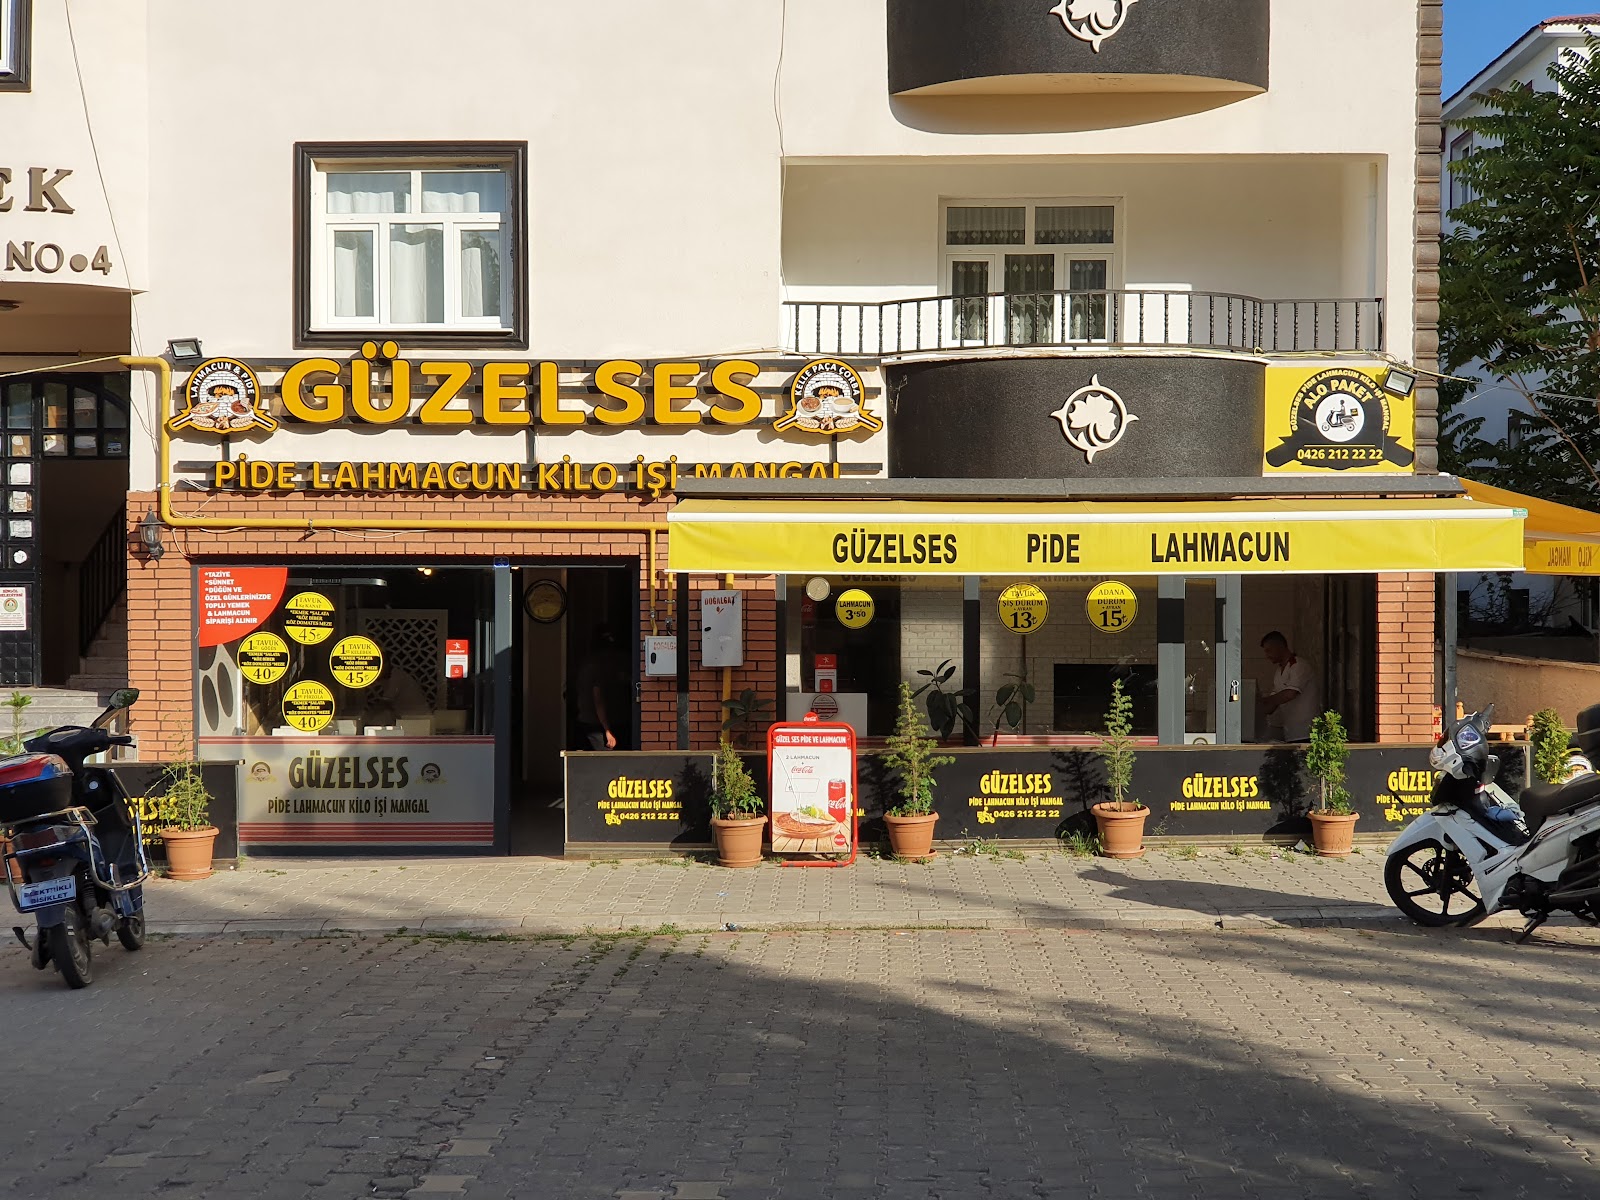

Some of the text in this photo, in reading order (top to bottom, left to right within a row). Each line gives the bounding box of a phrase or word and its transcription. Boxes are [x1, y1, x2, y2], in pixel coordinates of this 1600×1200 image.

[190, 361, 231, 398] LAHMACUN
[233, 366, 241, 375] &
[281, 340, 763, 425] GÜZELSES
[794, 362, 860, 396] KELLE PAÇA ÇORBA
[1303, 379, 1373, 410] ALO PAKET
[1297, 449, 1383, 460] 0426 212 22 22
[215, 453, 297, 489] PİDE
[313, 461, 521, 490] LAHMACUN
[538, 454, 617, 491] KİLO
[636, 454, 677, 498] İŞİ
[832, 528, 958, 564] GÜZELSES
[1151, 531, 1290, 563] LAHMACUN
[288, 750, 409, 789] GÜZELSES
[980, 770, 1052, 794] GÜZELSES
[608, 777, 673, 798] GÜZELSES
[1182, 773, 1259, 798] GÜZELSES
[268, 797, 291, 814] PİDE
[293, 799, 346, 814] LAHMACUN
[349, 797, 371, 814] KİLO
[390, 799, 430, 814] MANGAL
[620, 812, 679, 820] 0426 212 22 22
[993, 810, 1060, 818] 0426 212 22 22
